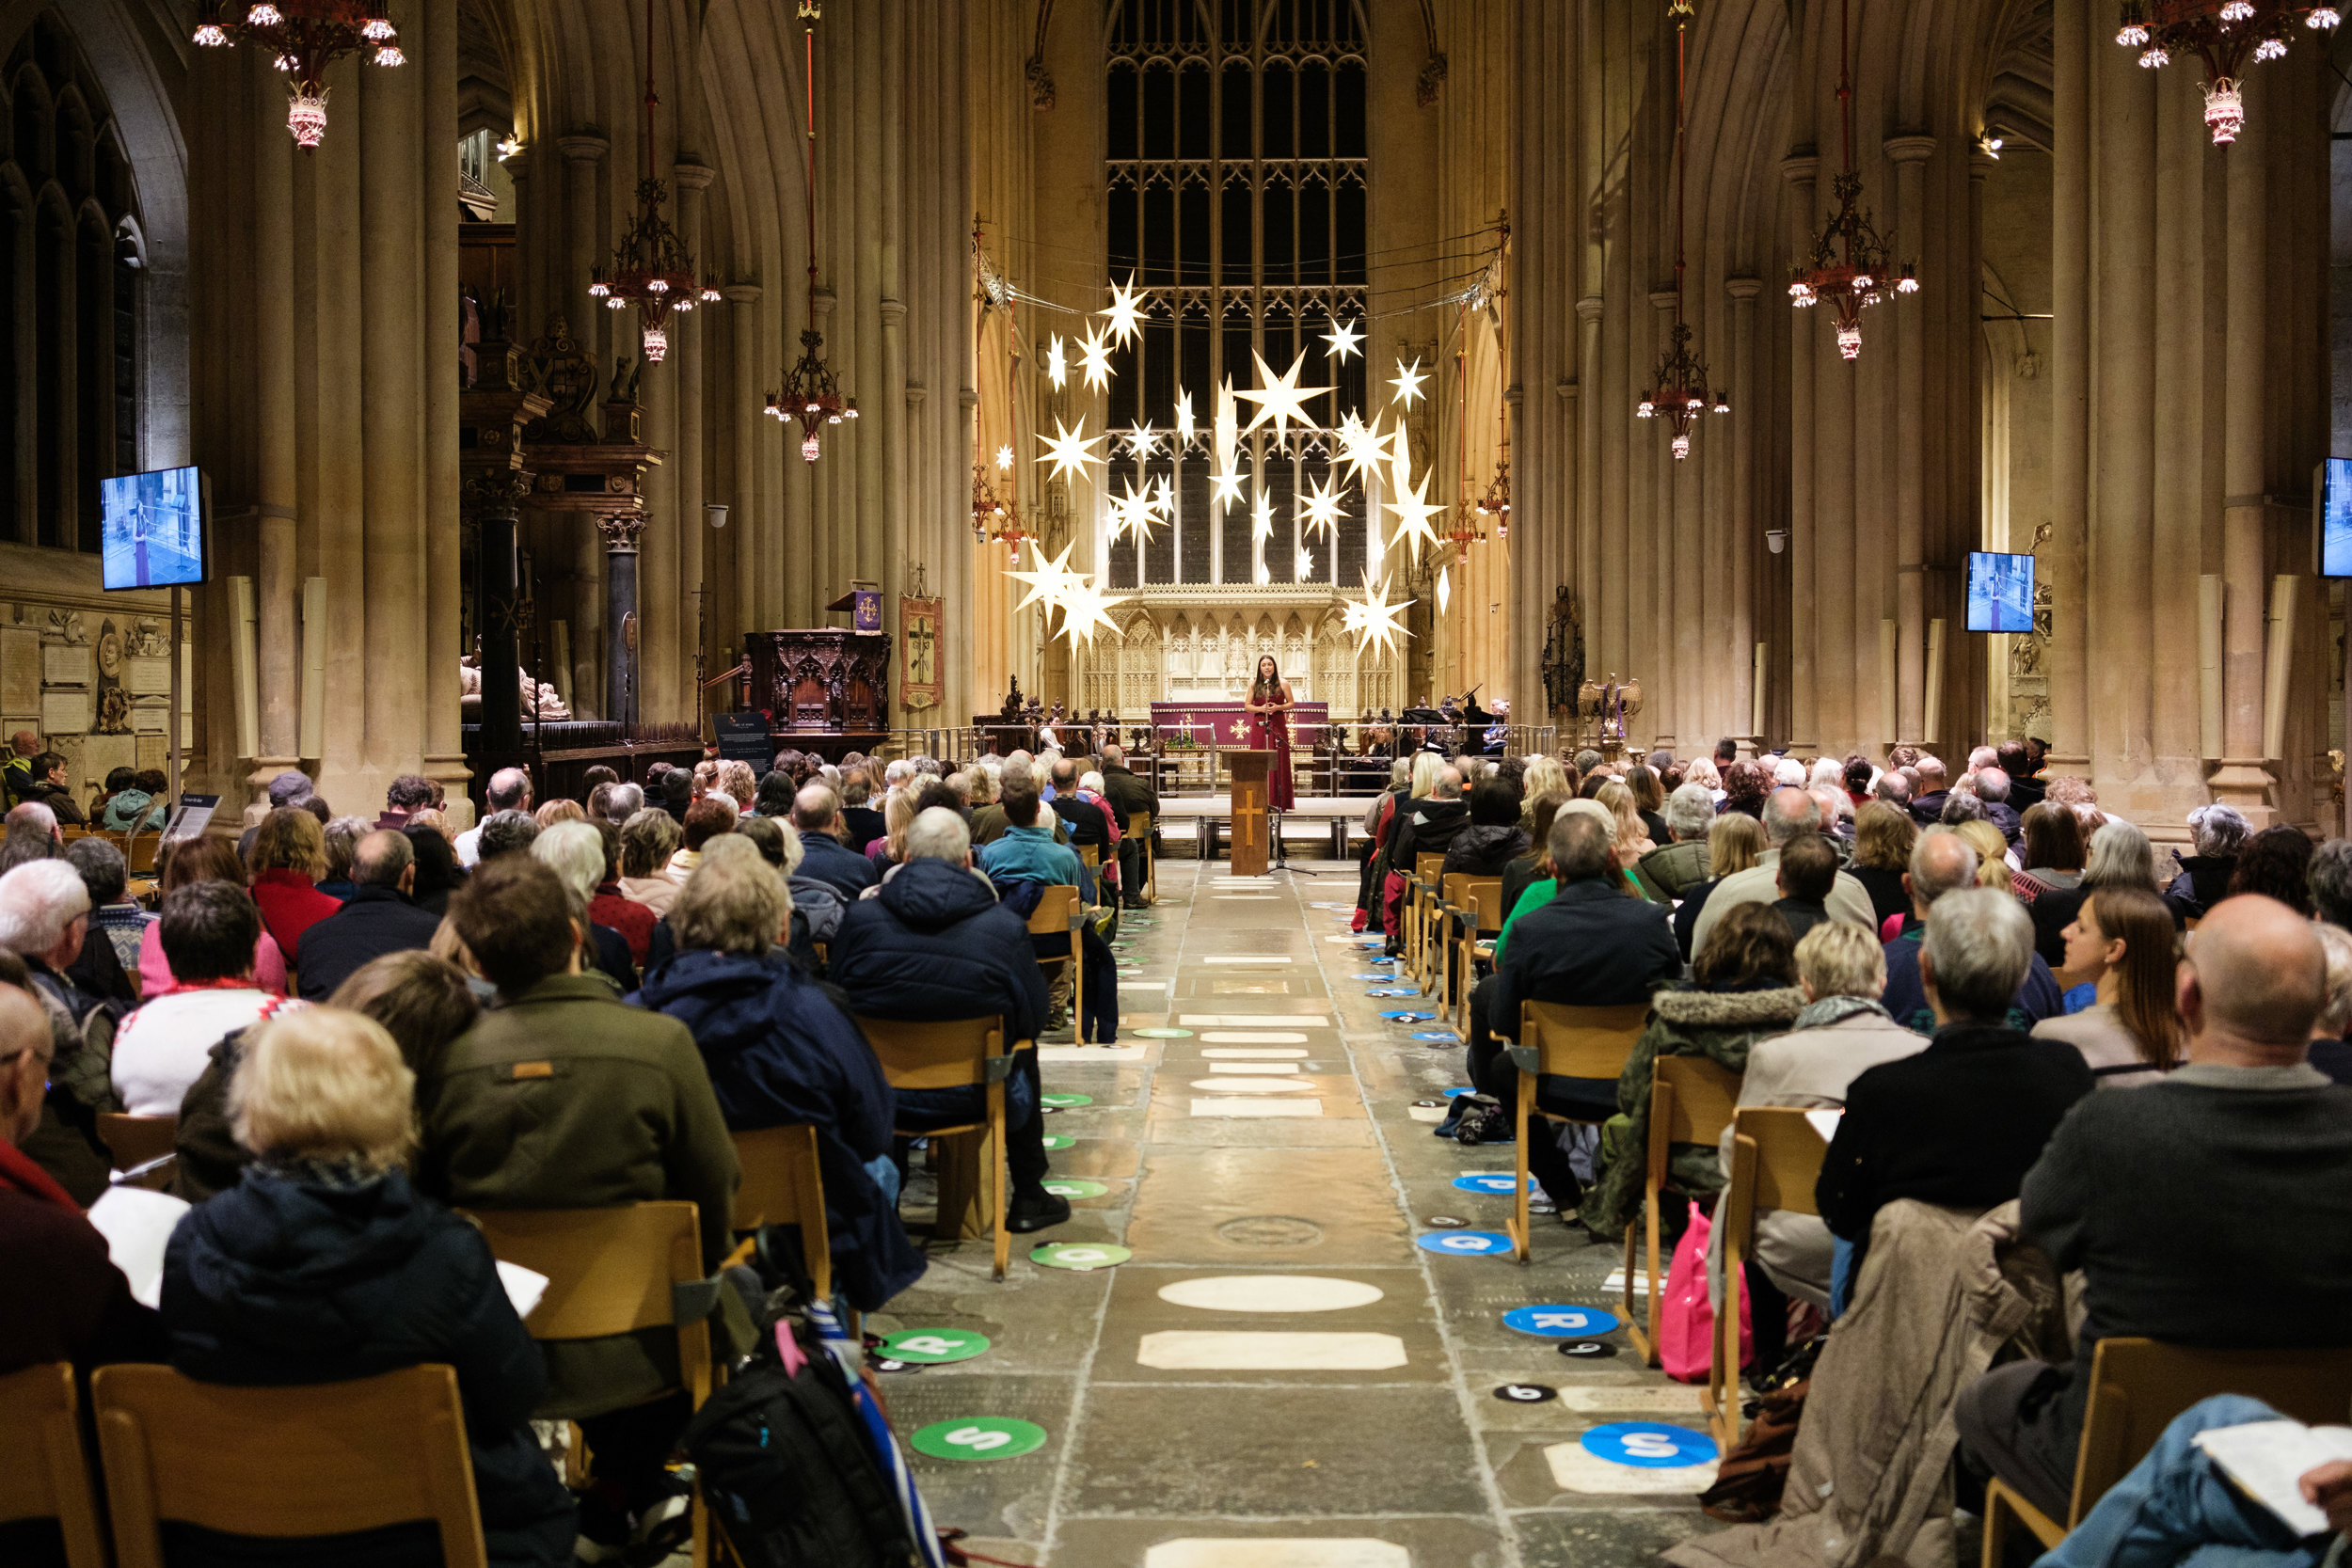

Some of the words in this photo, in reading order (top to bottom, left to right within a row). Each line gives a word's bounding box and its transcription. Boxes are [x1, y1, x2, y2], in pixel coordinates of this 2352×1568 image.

[1441, 1236, 1492, 1251] Q
[1055, 1248, 1108, 1262] Q
[1532, 1313, 1588, 1329] R
[896, 1336, 965, 1354] R
[945, 1426, 1011, 1450] S
[1620, 1433, 1679, 1458] S
